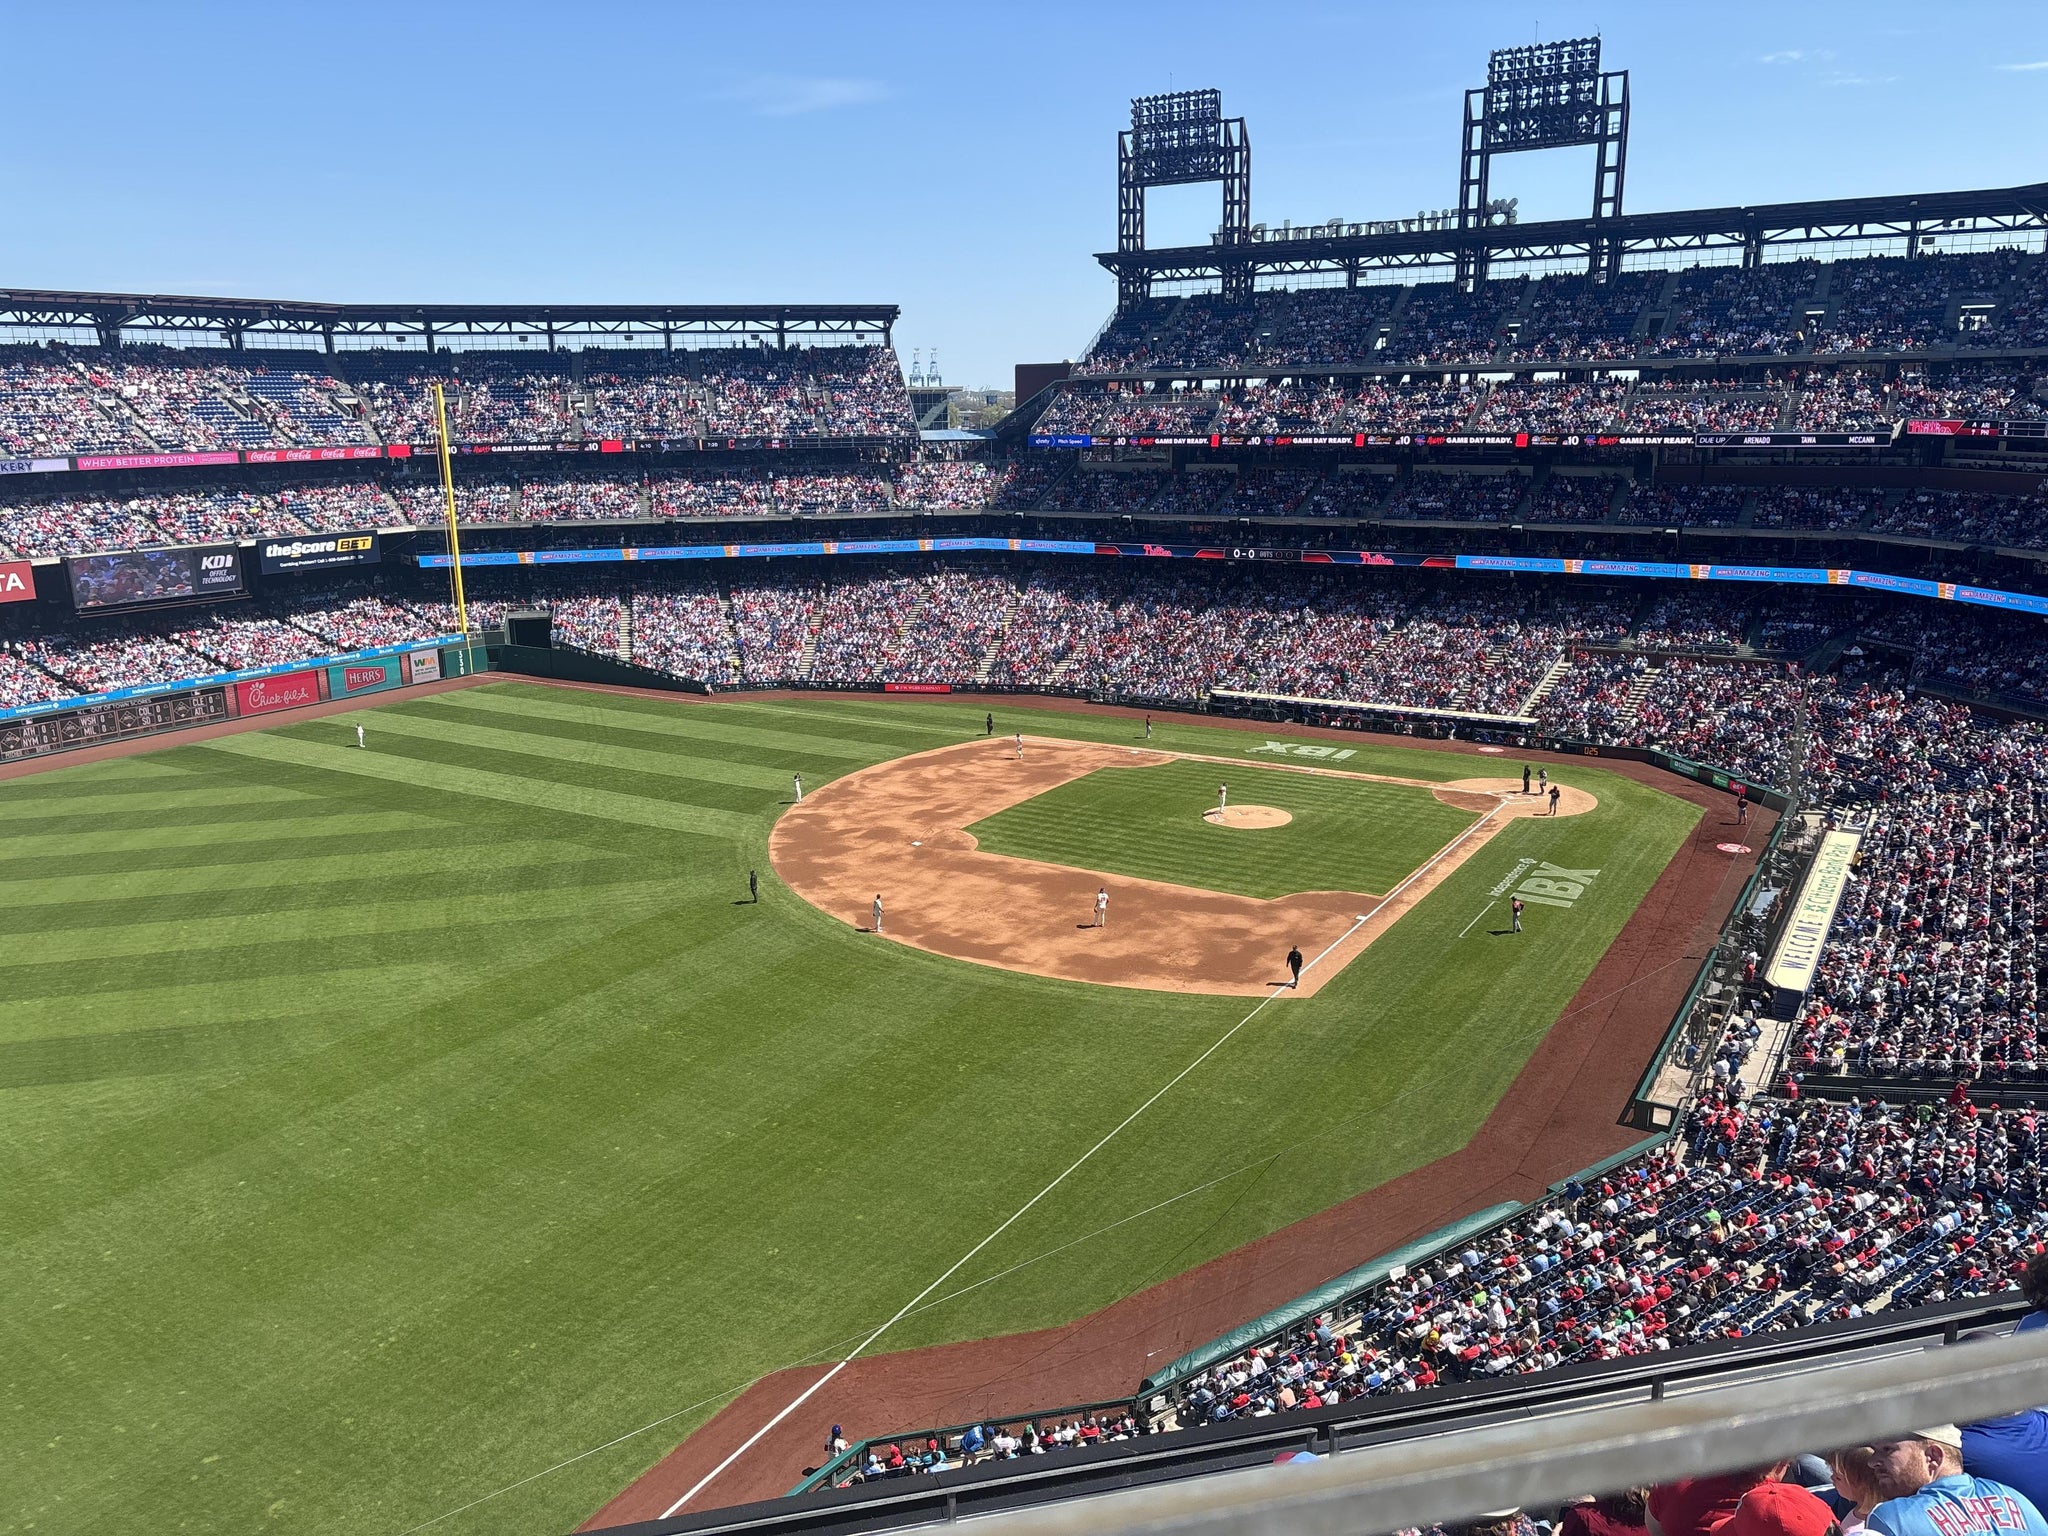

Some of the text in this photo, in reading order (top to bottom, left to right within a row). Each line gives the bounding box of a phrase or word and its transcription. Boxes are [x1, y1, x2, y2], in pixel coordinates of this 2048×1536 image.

[1117, 437, 1126, 446] 10
[1251, 436, 1261, 445] 10
[1400, 436, 1410, 445] 10
[1568, 435, 1579, 446] 10
[1743, 436, 1876, 444] ARENADO TAWA MCCANN
[354, 447, 377, 458] Coca-Cola
[588, 443, 598, 451] 10
[250, 451, 277, 461] Coca-Cola
[286, 450, 312, 461] Coca-Cola
[321, 448, 345, 459] Coca-Cola
[0, 461, 33, 471] KERY
[83, 460, 113, 468] WHEY
[116, 458, 152, 466] BETTER
[154, 455, 194, 464] PROTEIN
[266, 540, 336, 558] theScore
[340, 538, 371, 550] BET
[1143, 544, 1172, 557] Phillies
[201, 554, 233, 570] KDI
[1360, 552, 1394, 565] Phillies
[209, 569, 227, 577] OFFICE
[1604, 564, 1639, 572] AMAZING
[1734, 569, 1770, 577] AMAZING
[202, 574, 237, 585] TECHNOLOGY
[1869, 576, 1896, 586] AMAZING
[1974, 591, 2006, 602] AMAZING
[414, 656, 435, 668] WM
[349, 668, 380, 684] HERR'S
[132, 685, 166, 694] Independence
[130, 698, 152, 707] SCORES
[192, 696, 213, 707] CLE 0
[249, 687, 309, 709] Chick-fil-A
[16, 704, 52, 714] Independence
[138, 705, 161, 716] COL 0
[194, 705, 214, 716] ATL 0
[80, 714, 105, 726] WSH 0
[142, 714, 162, 726] SD 0
[23, 725, 56, 737] ATH 0 1
[84, 726, 97, 736] MIL
[22, 735, 48, 747] NYM 0
[1250, 740, 1358, 760] IBX
[1825, 844, 1852, 859] Park
[1818, 858, 1846, 876] Bank
[1509, 861, 1601, 908] IBX
[1808, 876, 1840, 905] Citizens
[1780, 919, 1823, 970] WELCOME
[1925, 1496, 2026, 1536] HARPER
